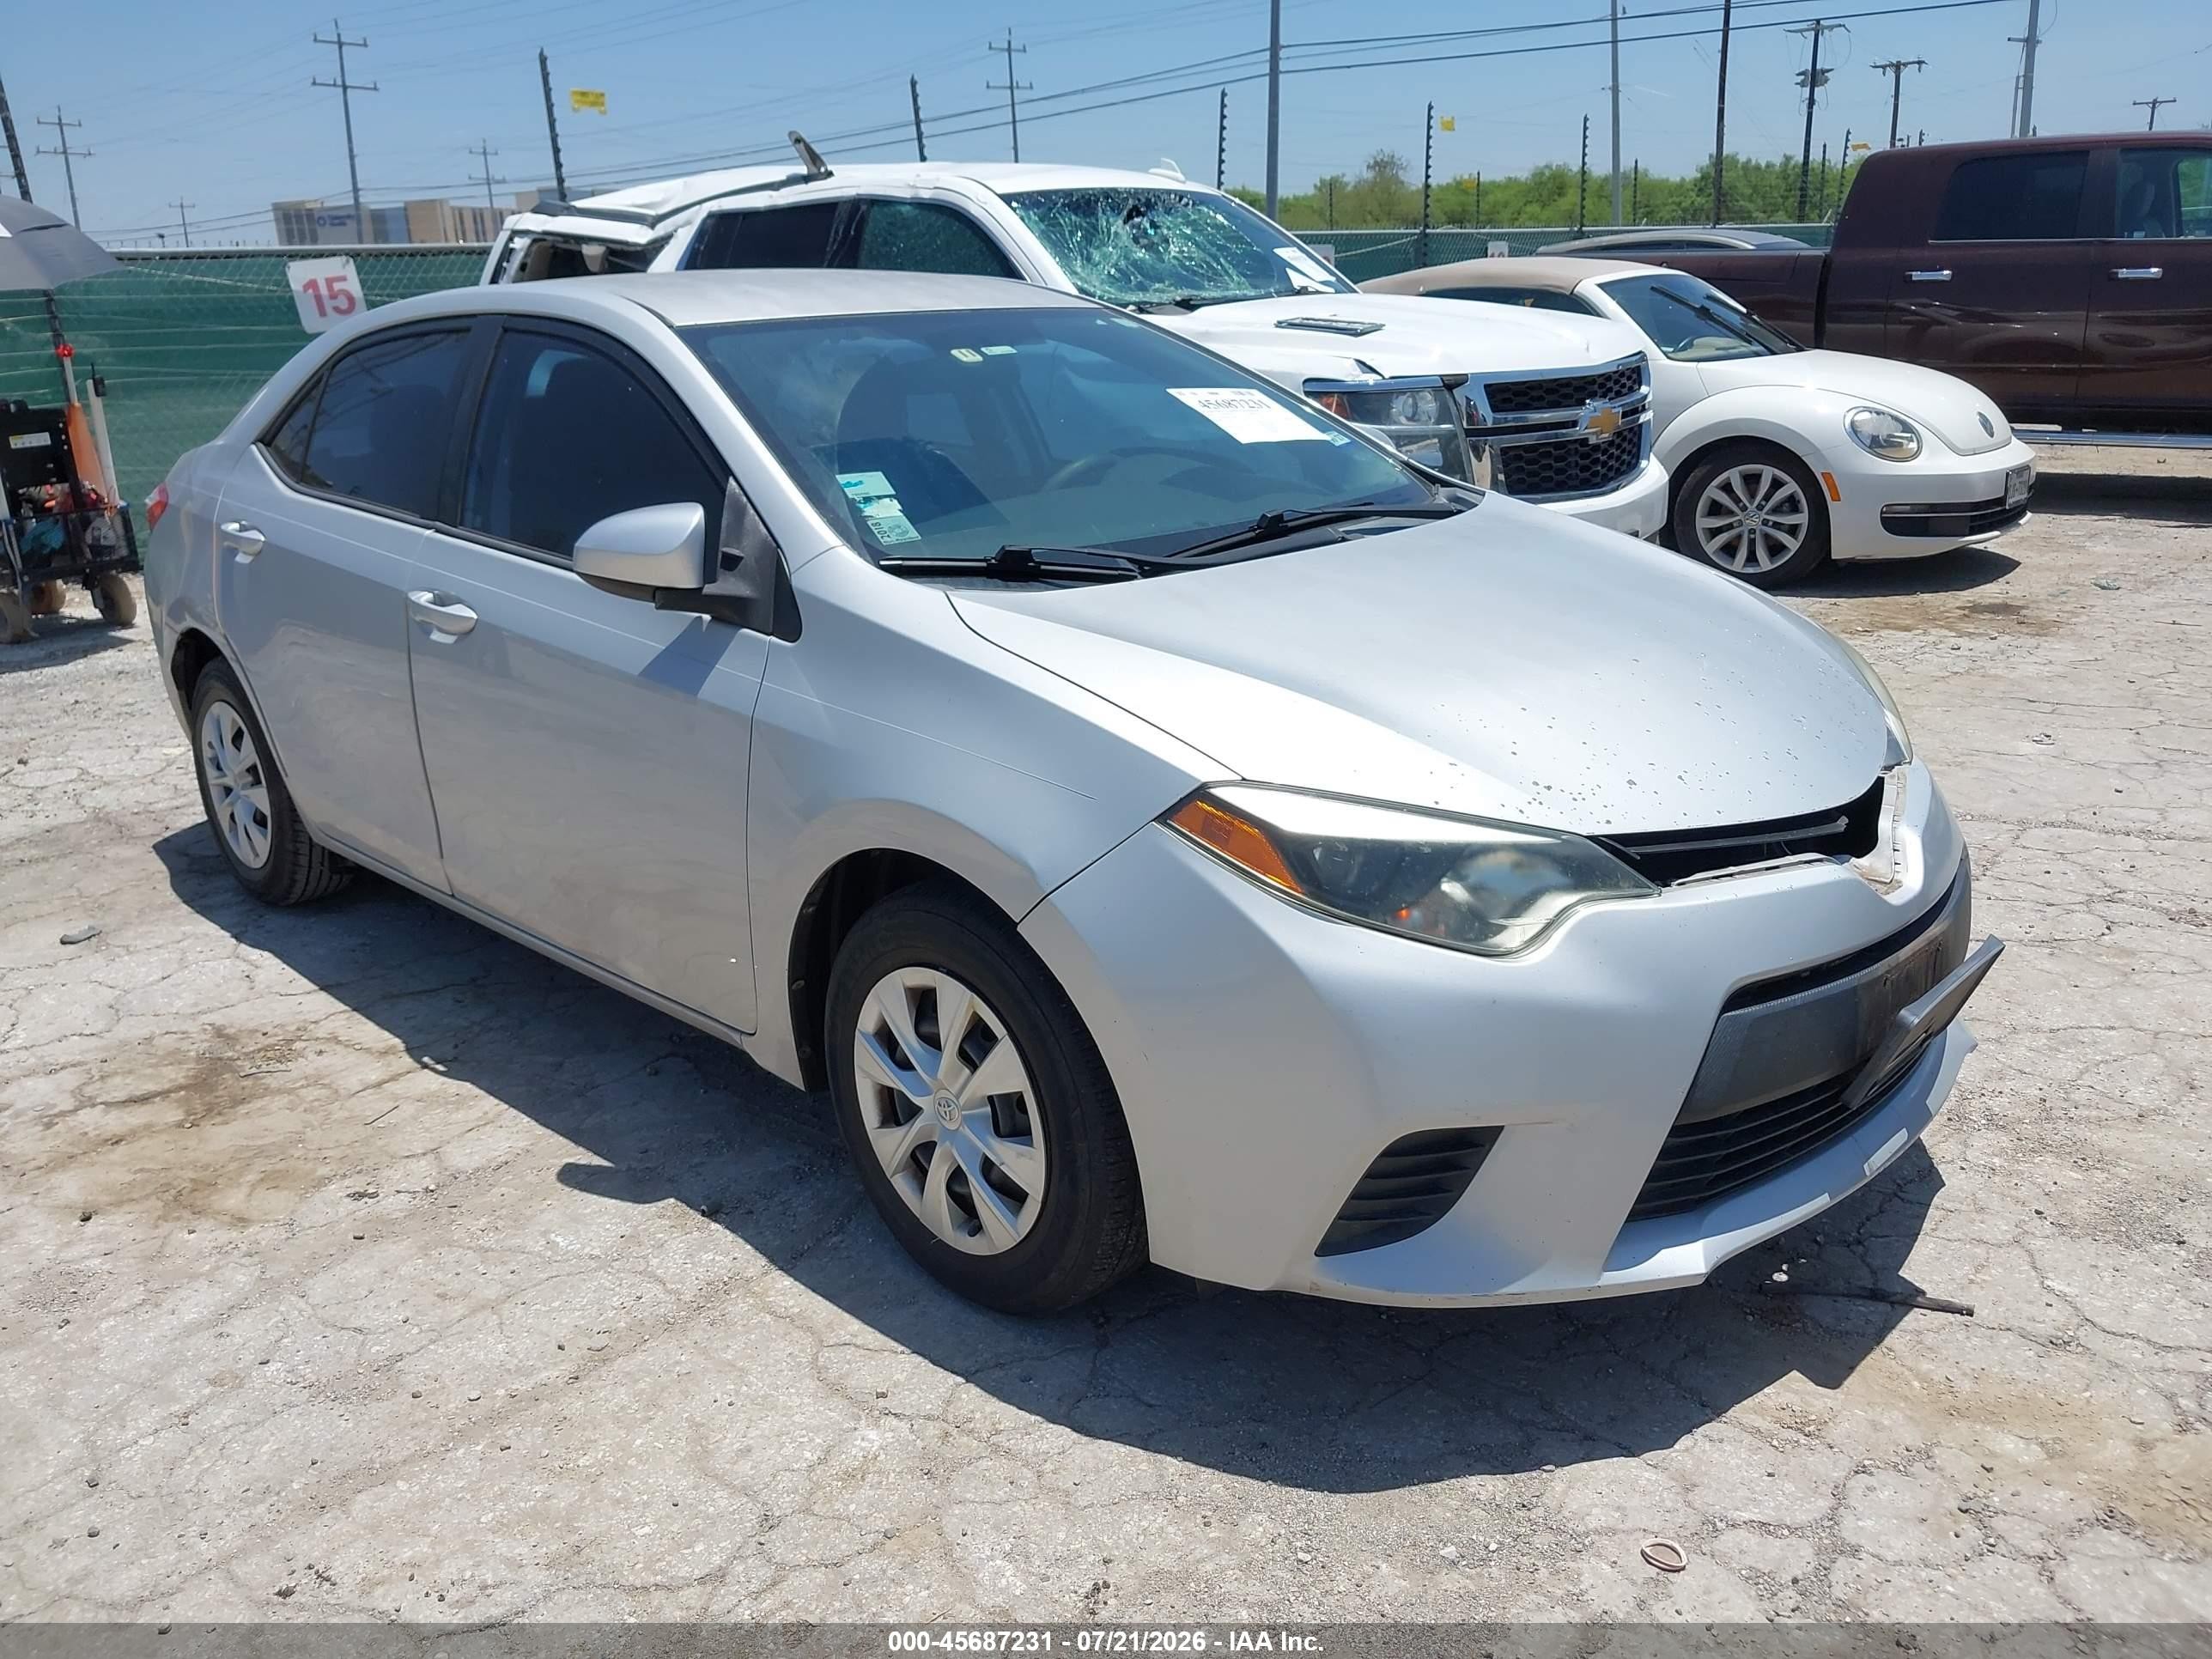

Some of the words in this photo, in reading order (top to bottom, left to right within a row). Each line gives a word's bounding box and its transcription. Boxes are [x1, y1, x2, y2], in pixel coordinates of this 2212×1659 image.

[302, 275, 356, 317] 15
[1197, 398, 1272, 410] 45687231
[871, 521, 892, 540] 2018
